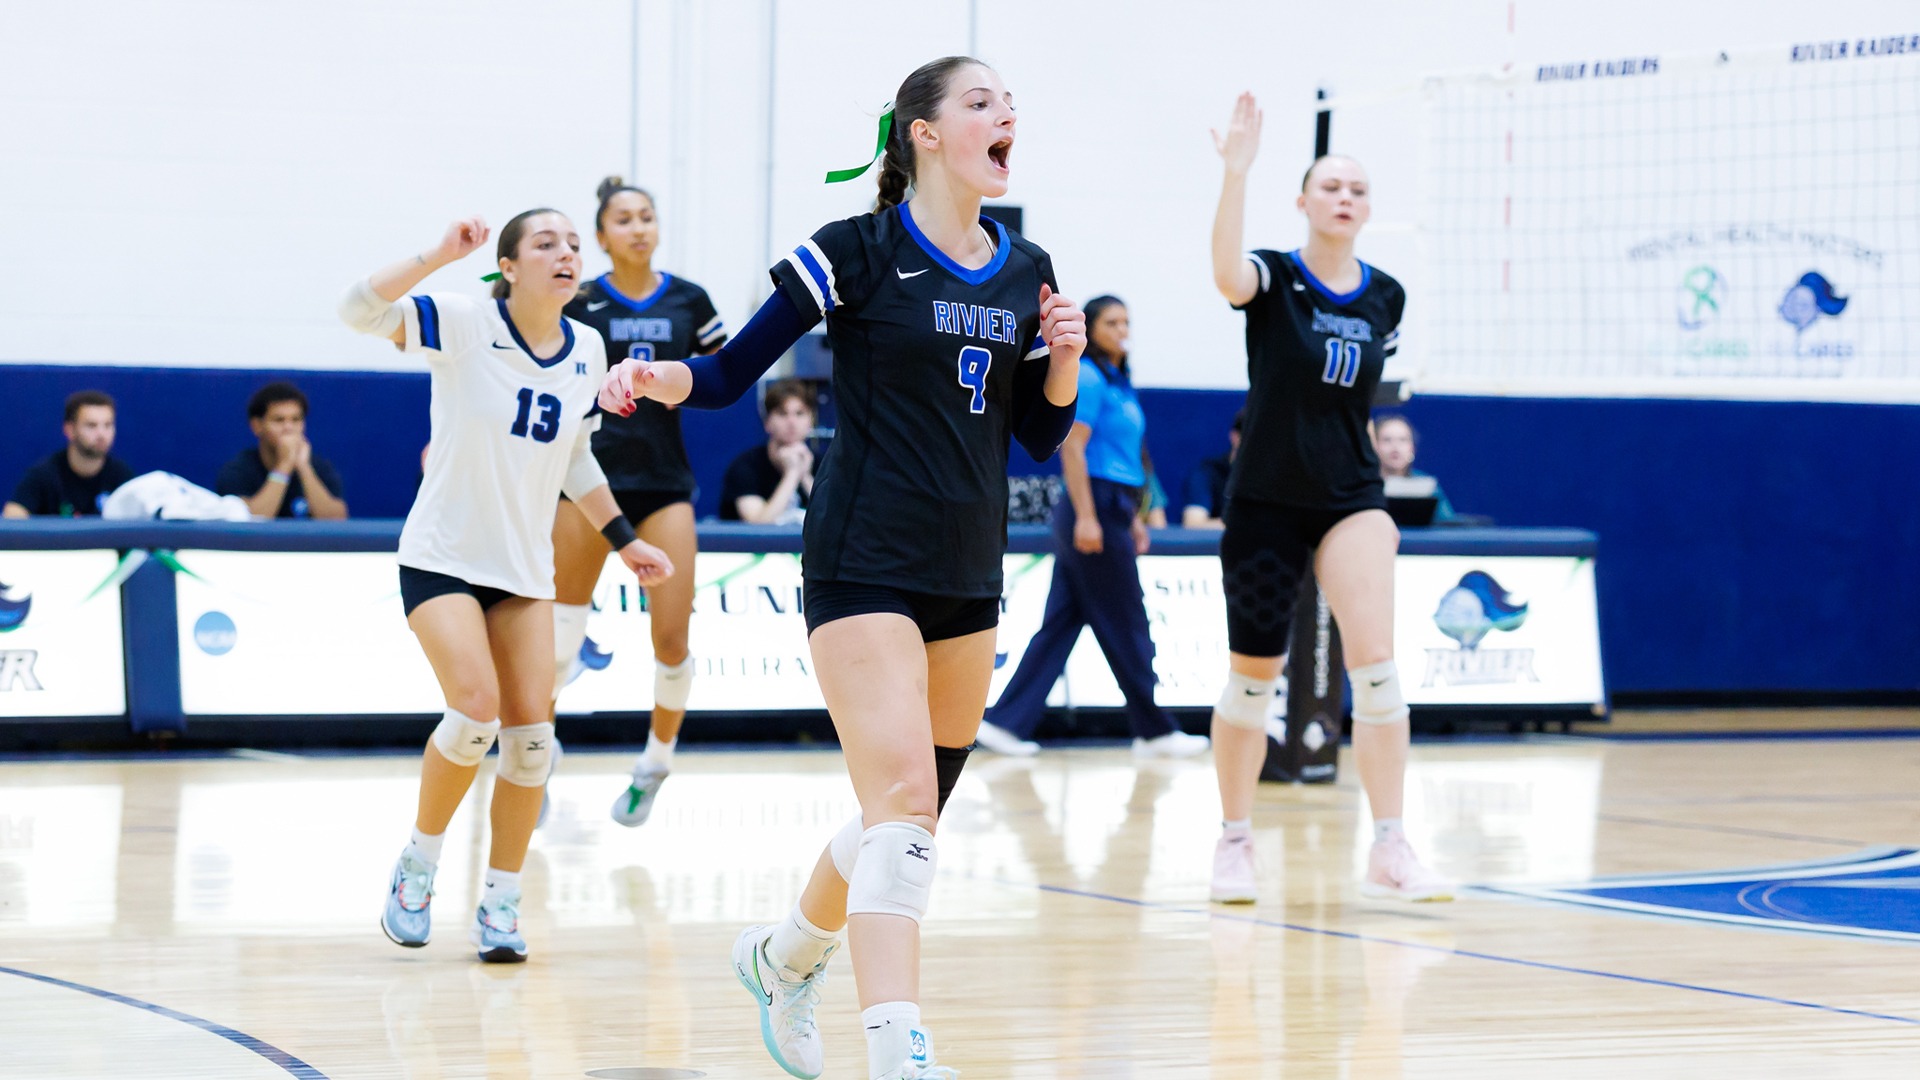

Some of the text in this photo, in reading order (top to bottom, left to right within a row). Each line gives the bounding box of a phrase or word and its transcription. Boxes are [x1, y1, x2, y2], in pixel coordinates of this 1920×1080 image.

[609, 317, 673, 342] RIVIER
[933, 300, 1017, 345] RIVIER
[957, 345, 993, 415] 9
[1321, 337, 1362, 388] 11
[511, 387, 562, 443] 13
[0, 649, 45, 692] R
